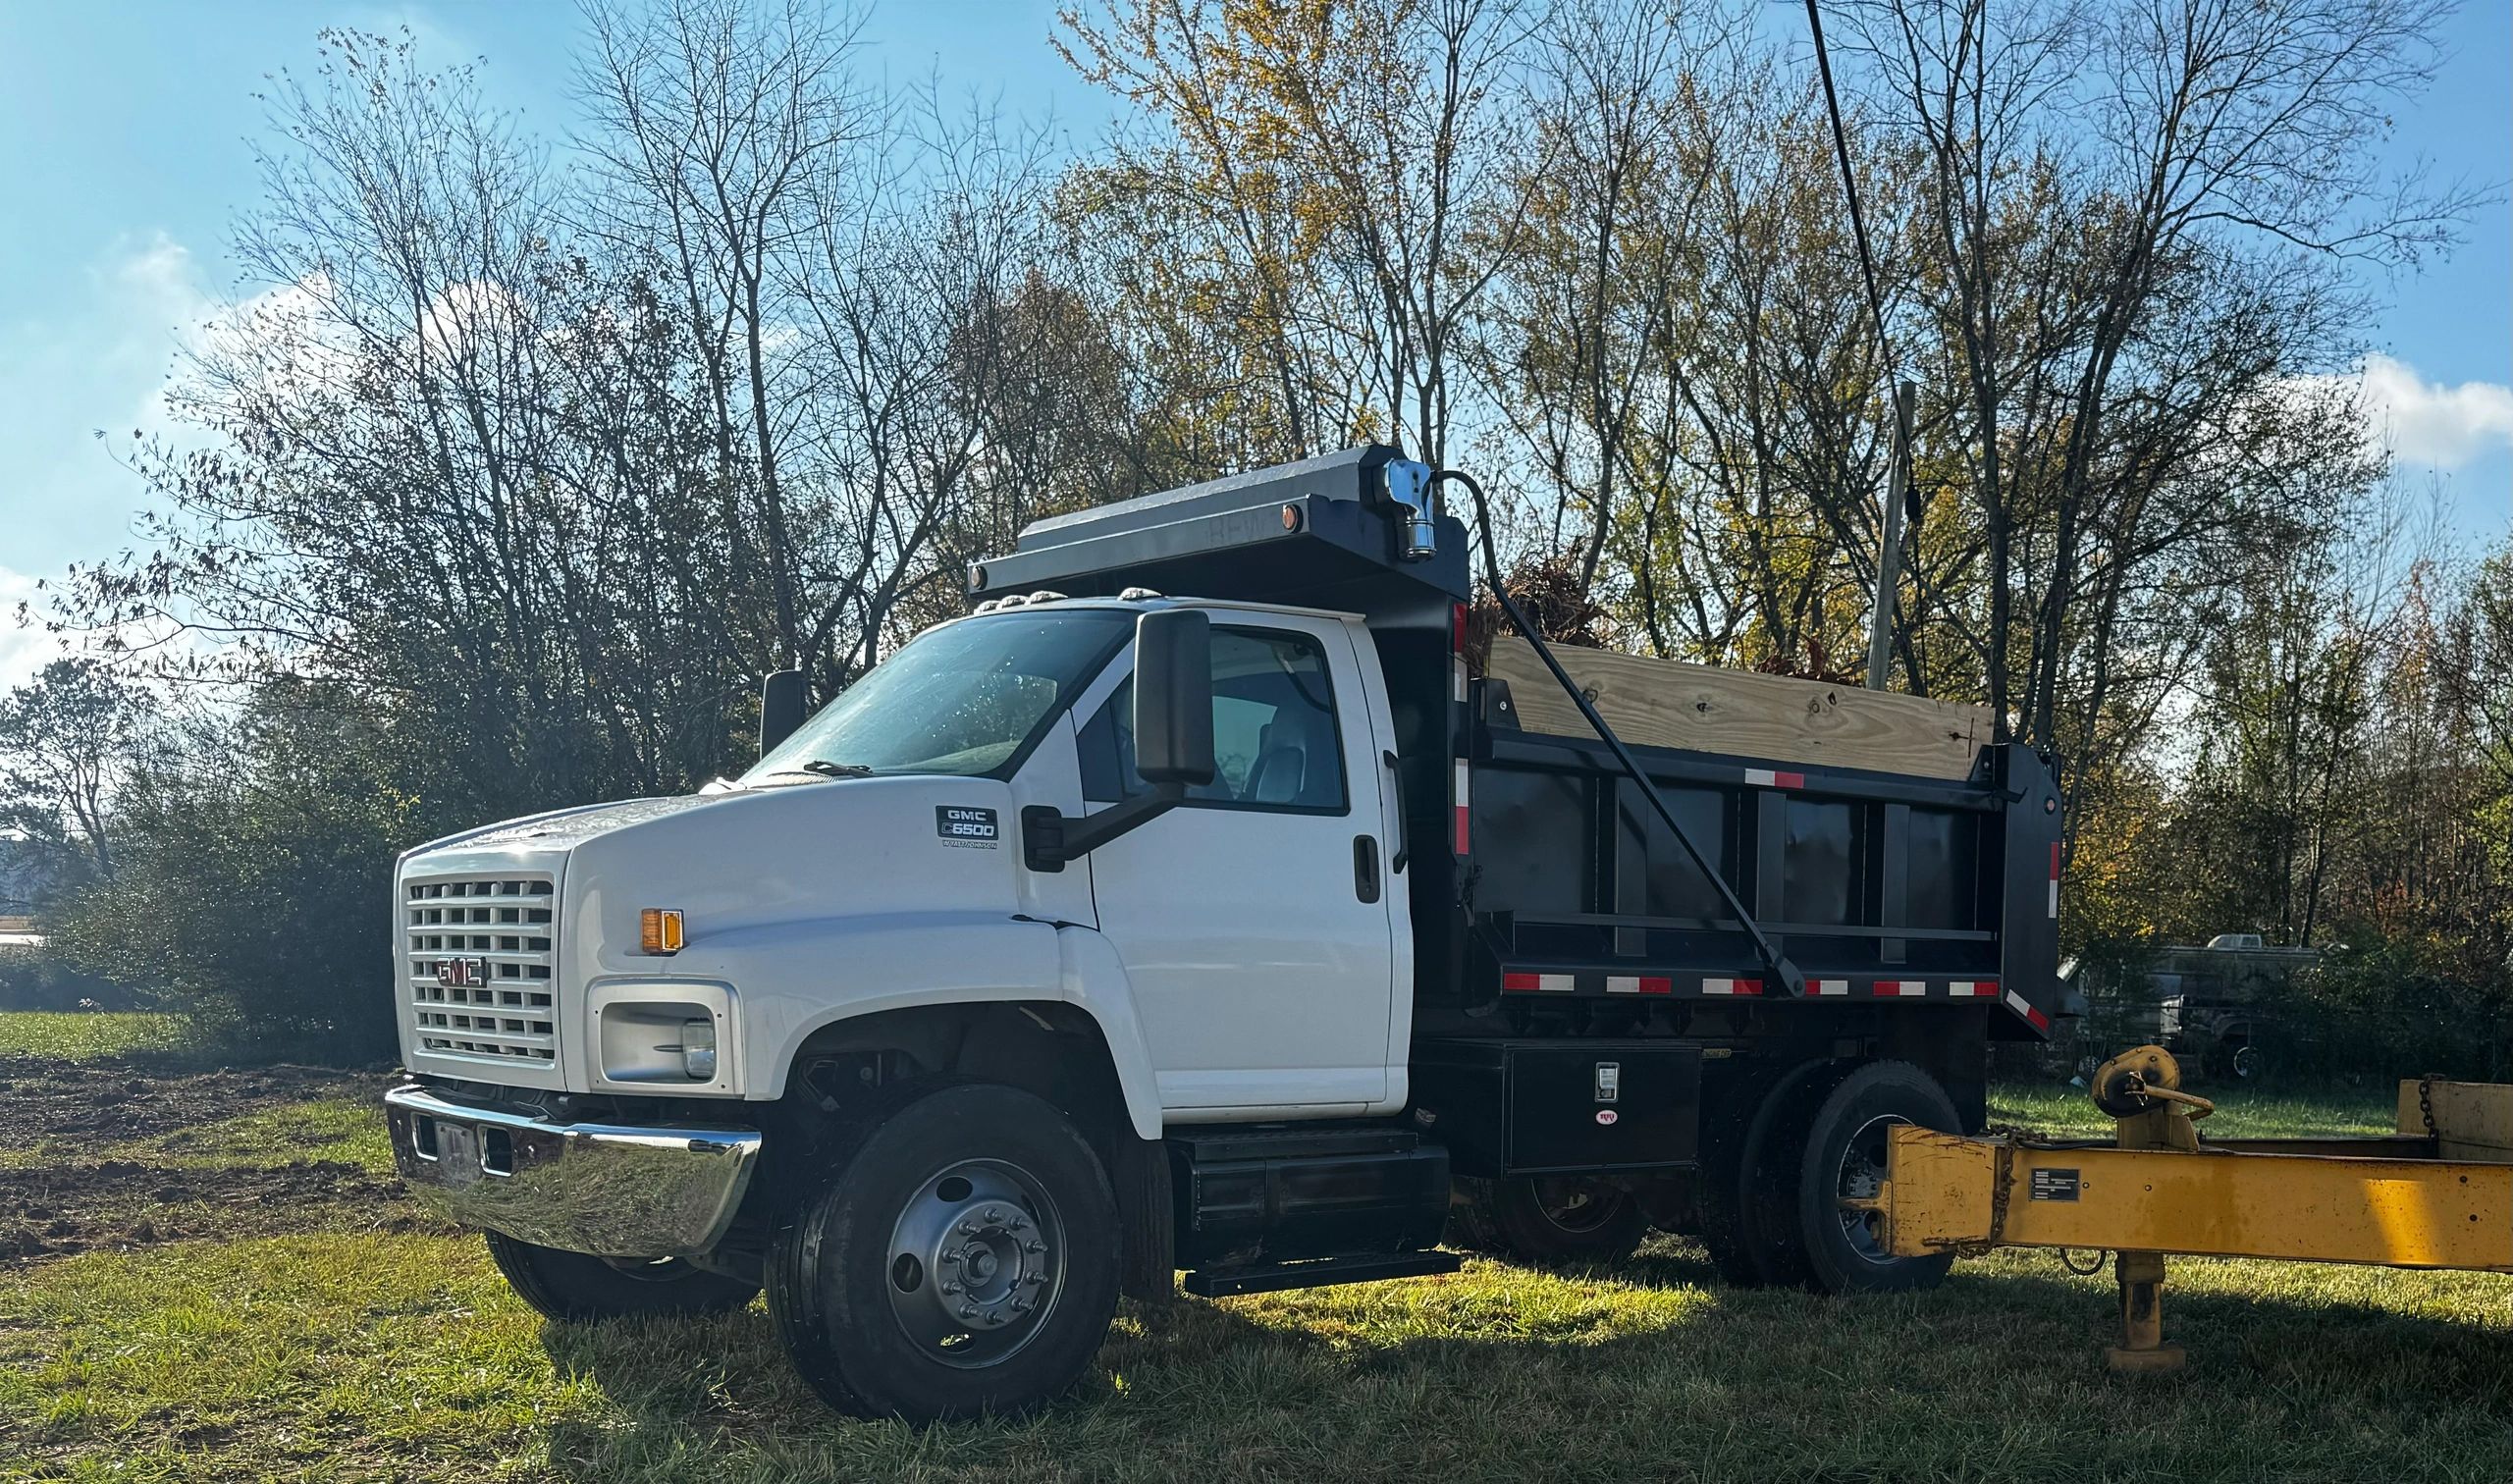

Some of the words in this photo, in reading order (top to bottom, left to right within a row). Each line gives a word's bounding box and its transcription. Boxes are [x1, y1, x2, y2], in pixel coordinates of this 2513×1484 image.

[947, 810, 987, 822] GMC
[942, 822, 994, 836] C6500
[437, 957, 487, 987] GMC
